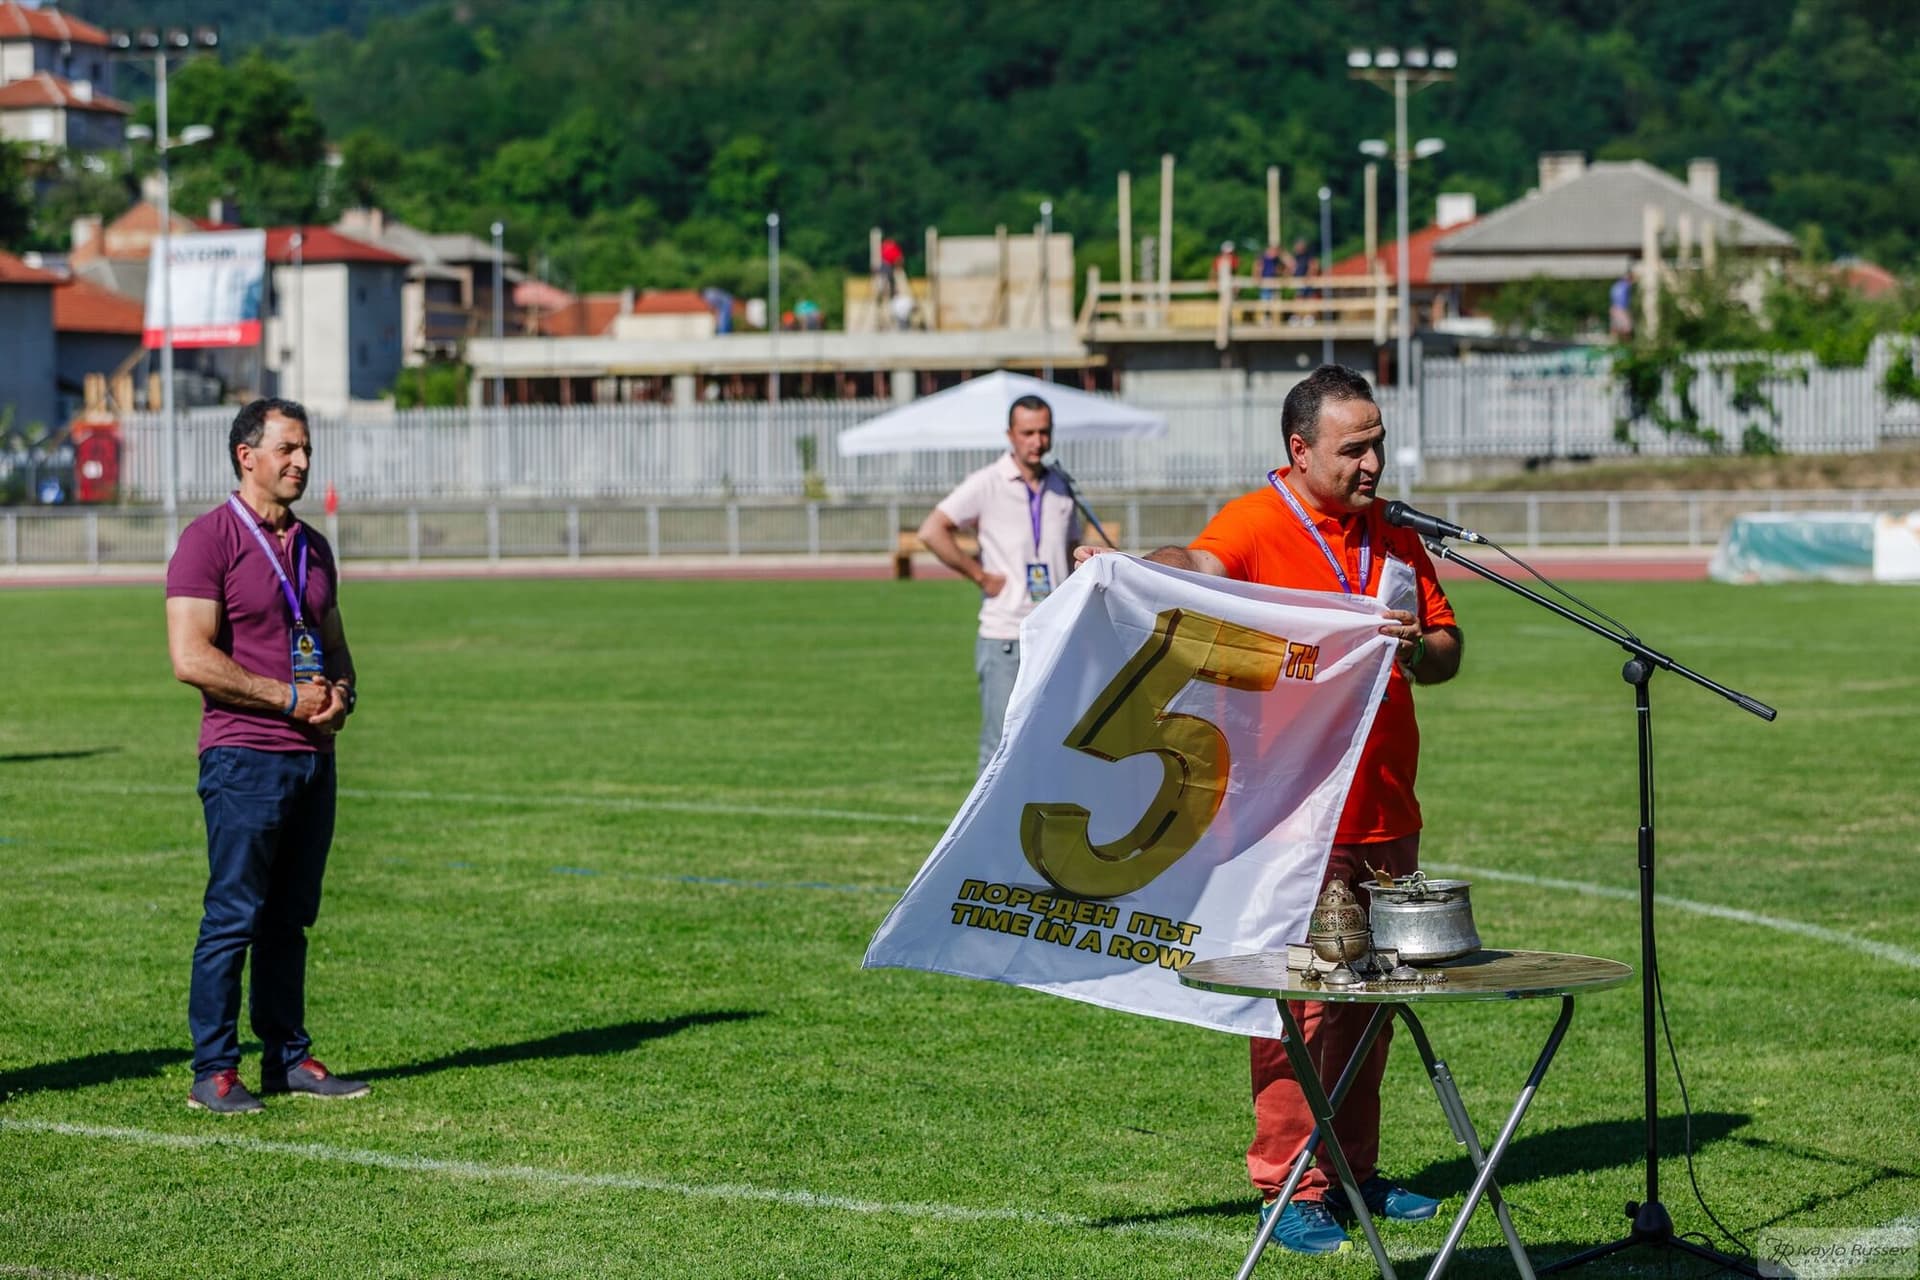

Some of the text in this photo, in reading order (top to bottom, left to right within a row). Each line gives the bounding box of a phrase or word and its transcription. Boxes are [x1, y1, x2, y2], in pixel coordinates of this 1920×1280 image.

[951, 902, 1195, 972] TIME IN A ROW
[958, 879, 1202, 946] ПОРЕДЕН ПЪТ
